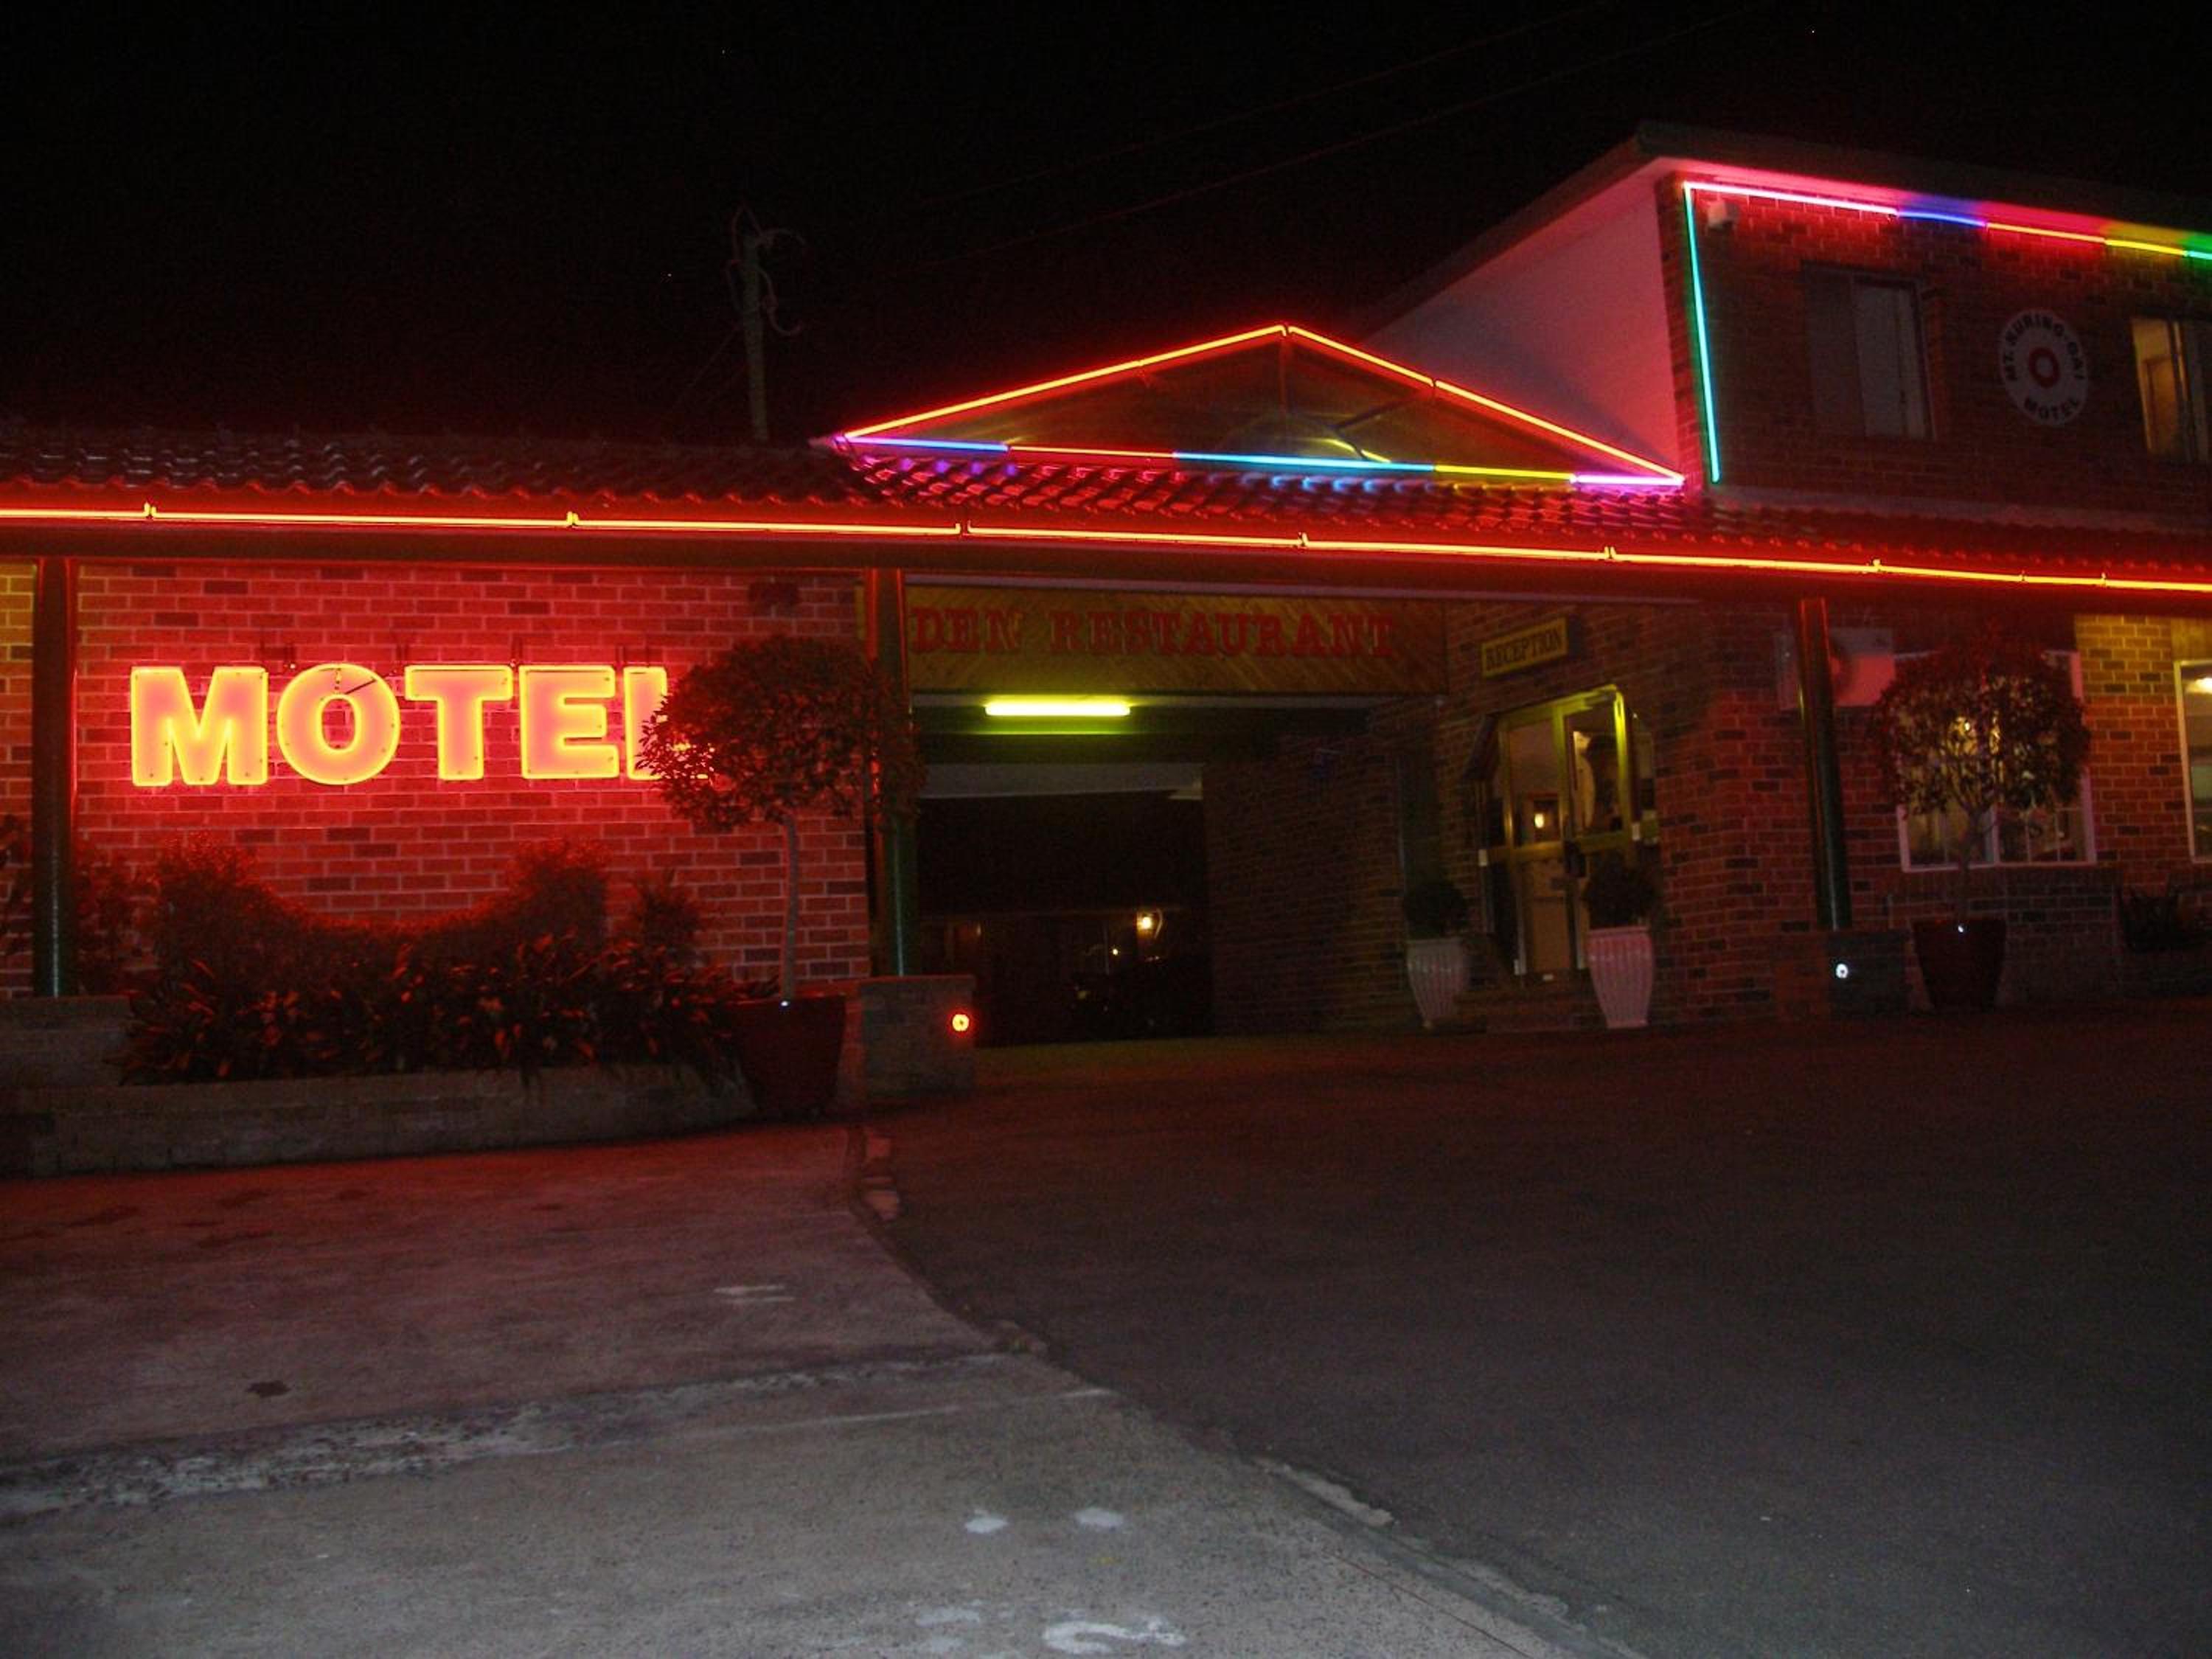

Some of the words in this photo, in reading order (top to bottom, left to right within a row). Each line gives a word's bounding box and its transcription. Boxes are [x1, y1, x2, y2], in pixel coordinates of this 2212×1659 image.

[2023, 397, 2078, 420] MOTEL
[1048, 610, 1394, 659] RESTAURANT
[1484, 624, 1563, 671] RECEPTION
[129, 662, 712, 789] MOTEL
